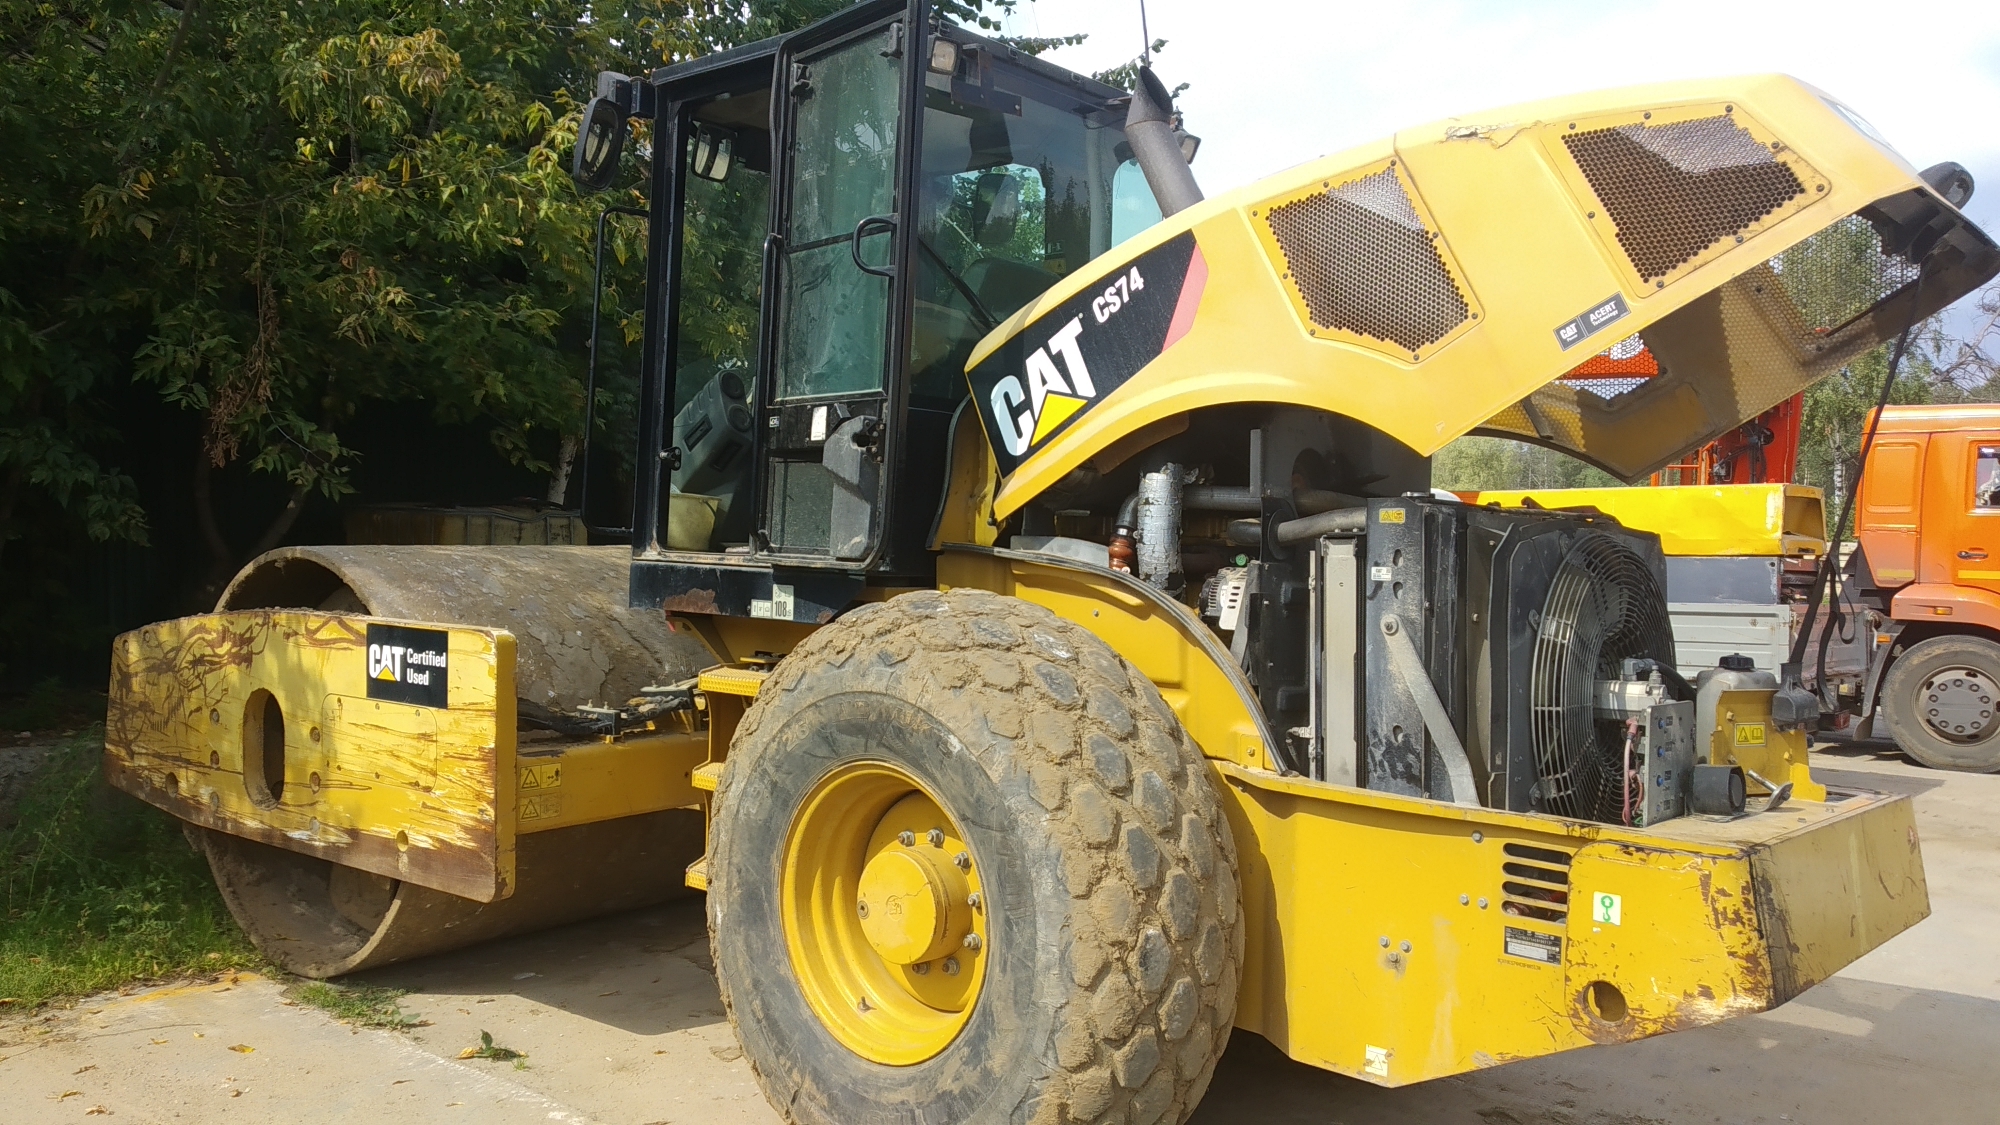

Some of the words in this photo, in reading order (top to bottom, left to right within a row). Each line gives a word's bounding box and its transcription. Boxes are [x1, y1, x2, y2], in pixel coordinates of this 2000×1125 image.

[1092, 266, 1144, 323] CS74
[1589, 300, 1616, 322] ACERT
[1559, 322, 1577, 340] CAT
[990, 316, 1096, 456] CAT
[774, 600, 787, 617] 108
[369, 643, 404, 681] CAT
[407, 648, 447, 668] Certified
[407, 668, 429, 686] Used
